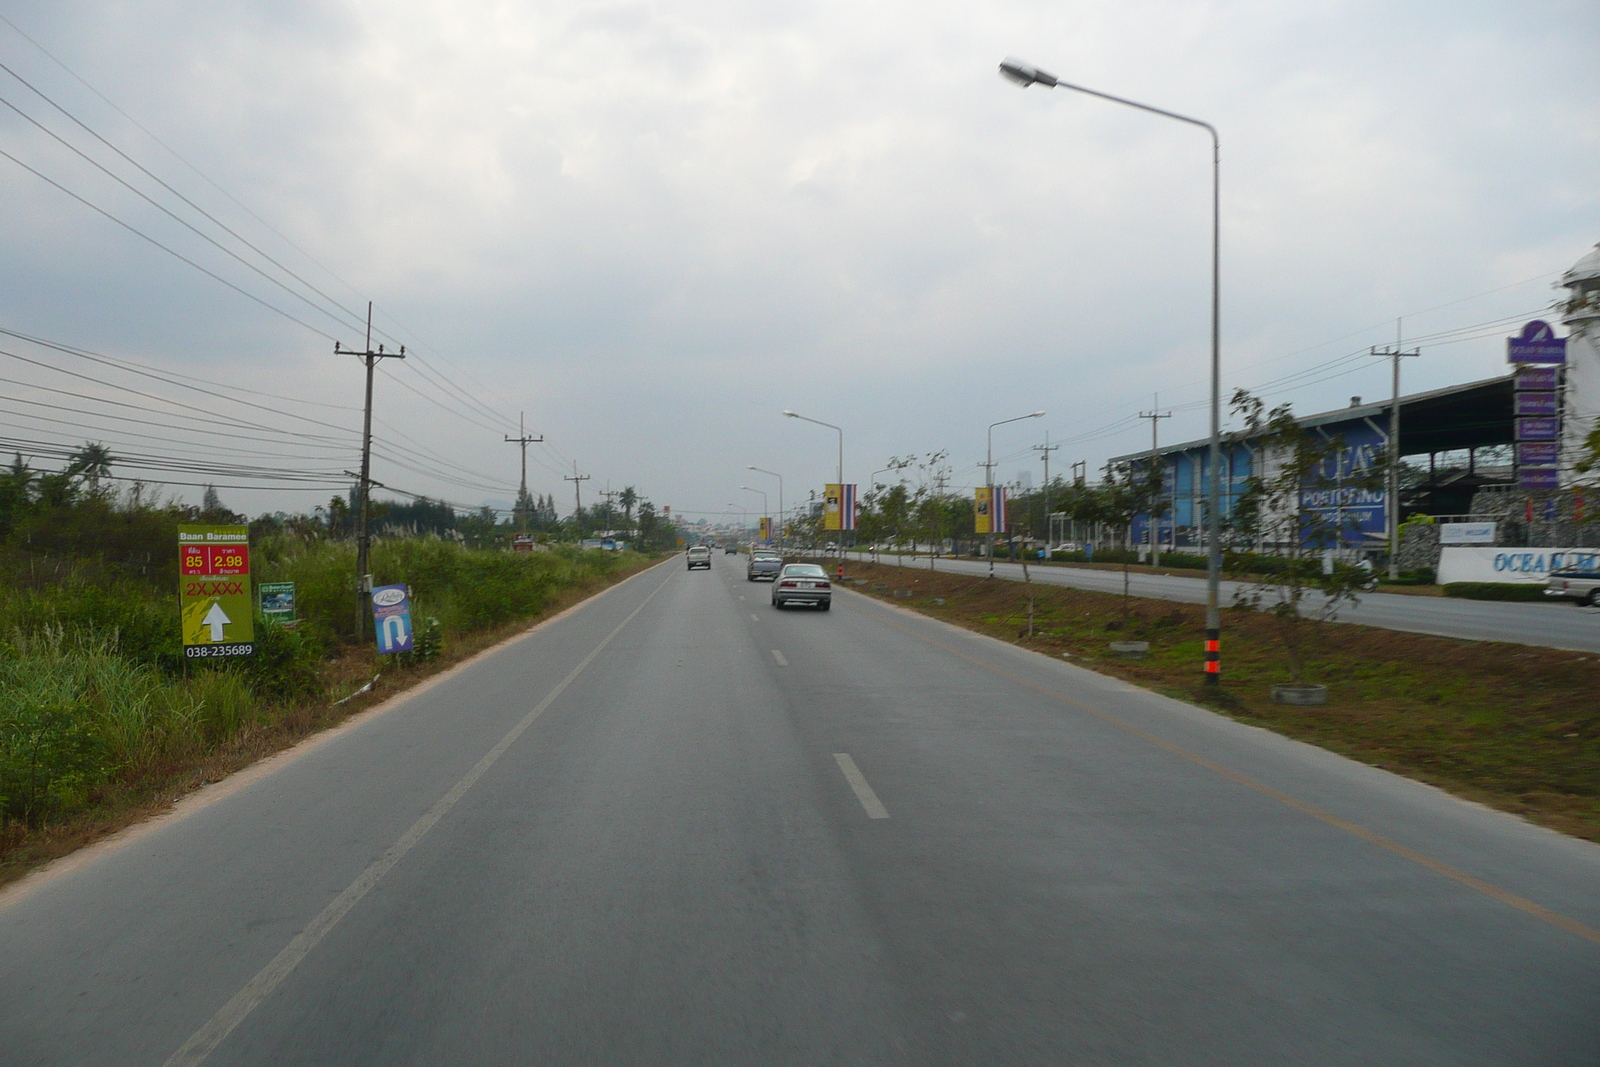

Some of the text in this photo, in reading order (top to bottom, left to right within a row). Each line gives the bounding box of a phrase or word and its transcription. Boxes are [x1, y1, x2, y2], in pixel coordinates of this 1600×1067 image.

[206, 532, 247, 540] Baramee
[186, 555, 203, 567] 85
[214, 555, 243, 567] 2.98
[1494, 552, 1565, 573] OCEAN
[186, 581, 244, 597] 2X,XXX
[186, 644, 253, 658] 038-235689
